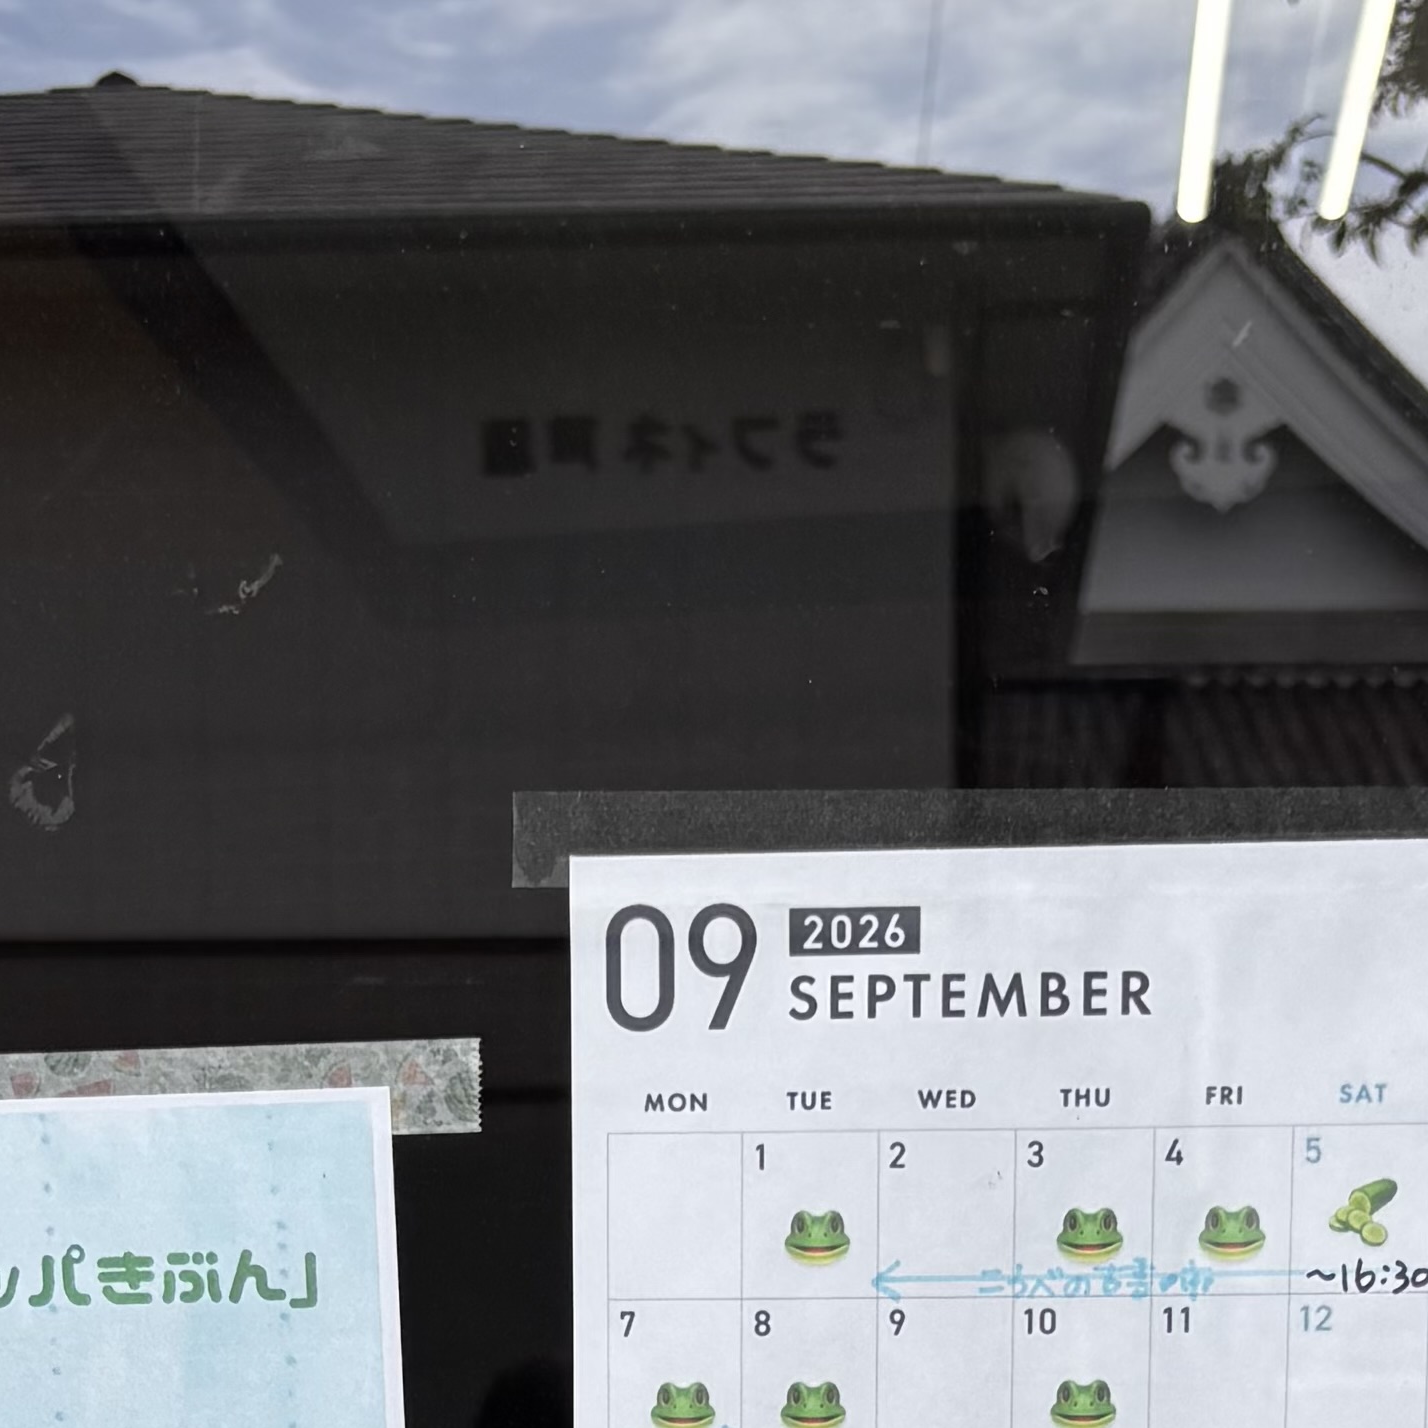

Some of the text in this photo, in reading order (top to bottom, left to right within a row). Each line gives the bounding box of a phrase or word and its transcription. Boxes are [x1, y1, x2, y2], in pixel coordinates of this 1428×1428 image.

[803, 914, 906, 949] 2026
[605, 902, 758, 1033] 09
[788, 970, 1152, 1021] SEPTEMBER
[644, 1092, 708, 1113] MON
[786, 1090, 832, 1111] TUE
[917, 1088, 977, 1110] WED
[1059, 1087, 1111, 1108] THU
[1205, 1085, 1243, 1106] FRI
[1339, 1083, 1387, 1104] SAT
[755, 1143, 765, 1171] 1
[888, 1141, 906, 1169] 2
[1026, 1140, 1045, 1168] 3
[1164, 1137, 1184, 1166] 4
[1305, 1137, 1322, 1164] 5
[619, 1310, 636, 1338] 7
[753, 1309, 772, 1337] 8
[888, 1308, 906, 1337] 9
[1023, 1307, 1057, 1336] 10
[1162, 1306, 1190, 1334] 11
[1300, 1304, 1333, 1332] 12
